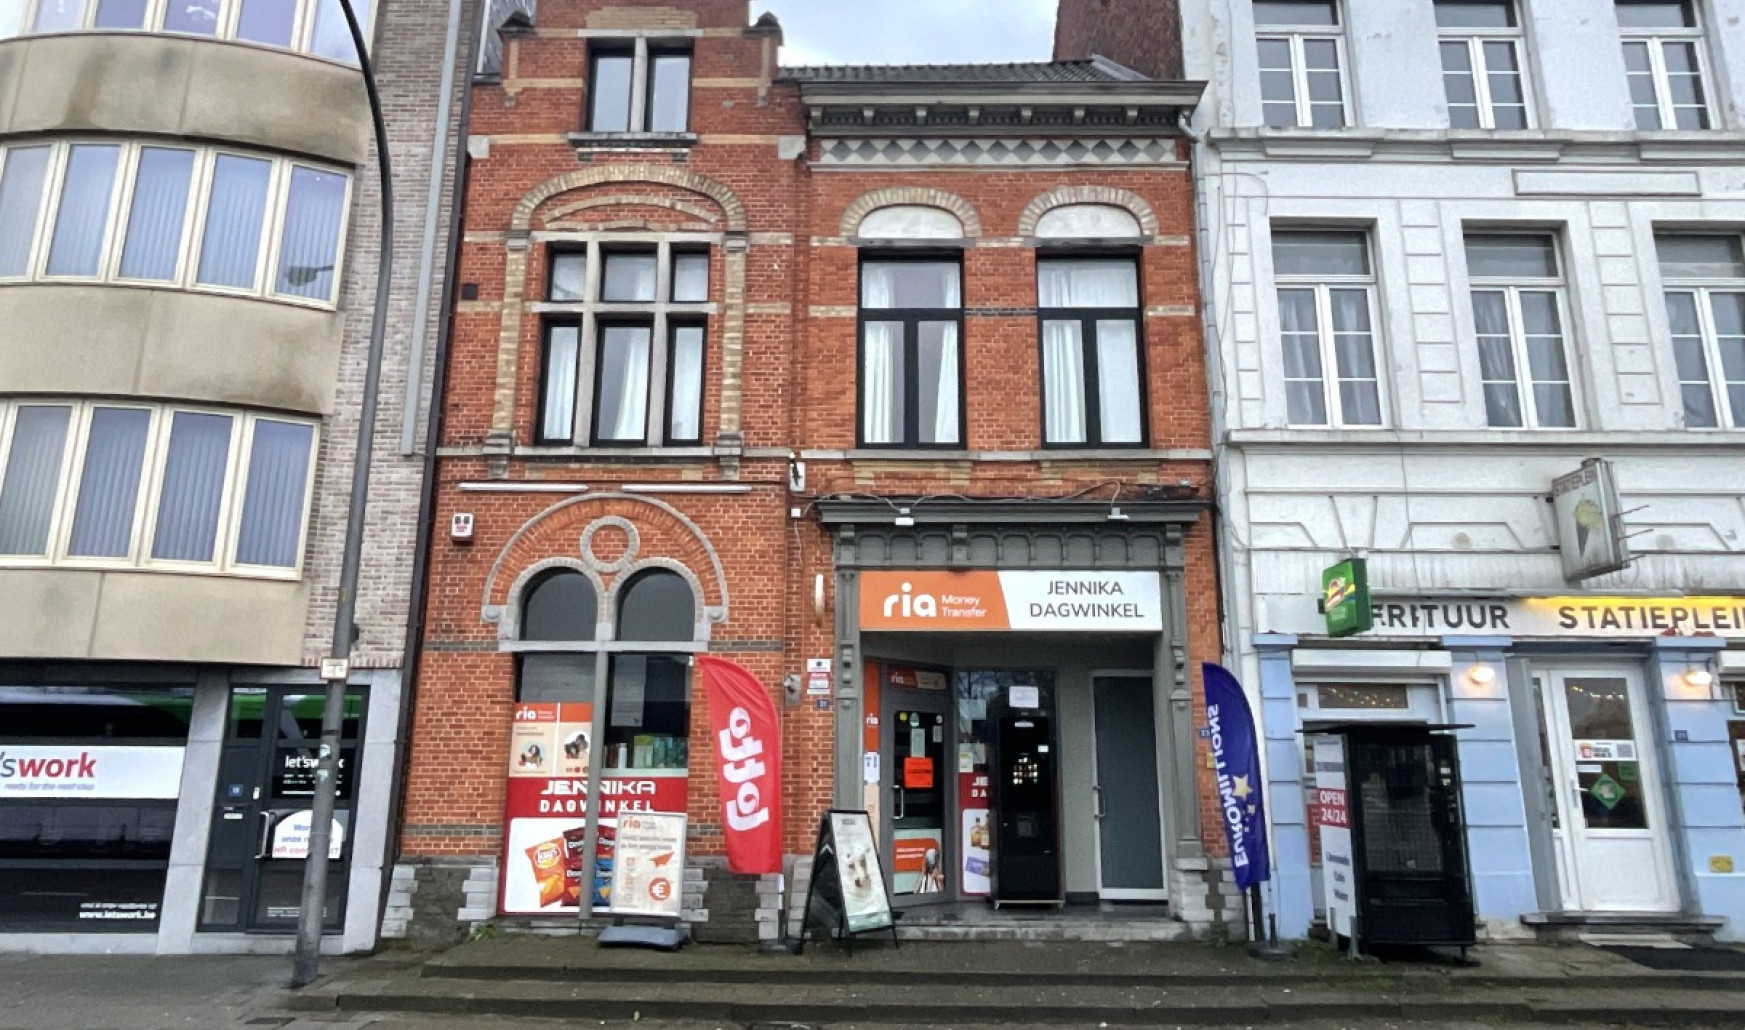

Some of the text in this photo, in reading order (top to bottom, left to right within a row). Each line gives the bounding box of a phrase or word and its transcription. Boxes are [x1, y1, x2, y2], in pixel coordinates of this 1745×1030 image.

[1047, 581, 1123, 595] JENNIKA
[883, 582, 980, 617] ria Money
[942, 607, 987, 618] Transfer
[1030, 603, 1144, 618] DAGWINKEL
[1558, 605, 1745, 629] STATIEPLEI
[890, 671, 904, 684] ria
[515, 705, 537, 720] ria
[866, 713, 879, 725] ria
[1319, 790, 1345, 806] OPEN
[622, 816, 641, 829] ria
[1321, 808, 1347, 824] 24/24
